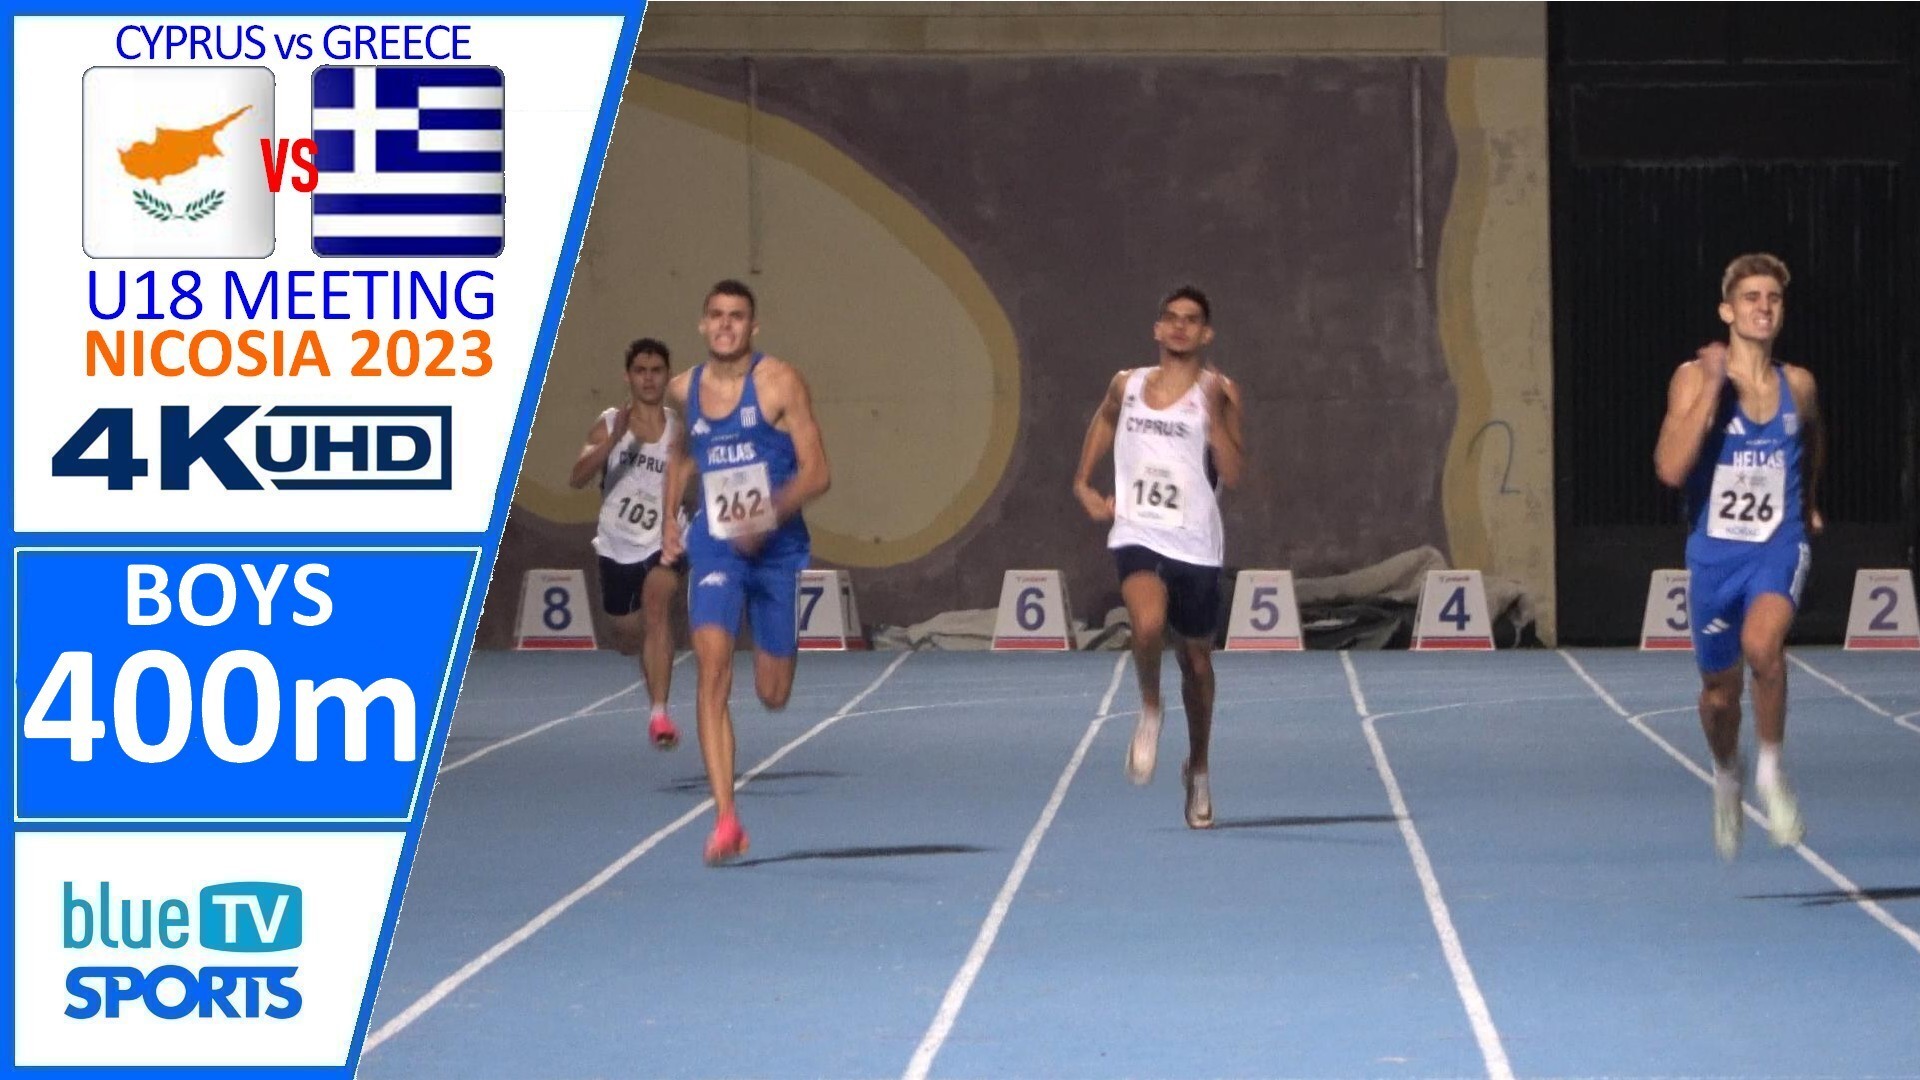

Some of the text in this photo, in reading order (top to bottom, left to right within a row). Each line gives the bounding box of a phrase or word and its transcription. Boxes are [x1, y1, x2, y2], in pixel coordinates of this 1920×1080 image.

[1127, 417, 1190, 437] CYPRUS
[620, 451, 664, 474] CYPRU
[1733, 450, 1784, 468] HELLAS
[618, 497, 658, 530] 103
[716, 489, 764, 522] 262
[1133, 480, 1178, 509] 162
[1720, 490, 1773, 522] 226
[543, 586, 572, 631] 8
[800, 587, 824, 631] 7
[1016, 587, 1045, 631] 6
[1250, 587, 1280, 631] 5
[1438, 587, 1471, 631] 4
[1666, 587, 1689, 631] 3
[1868, 586, 1899, 631] 2
